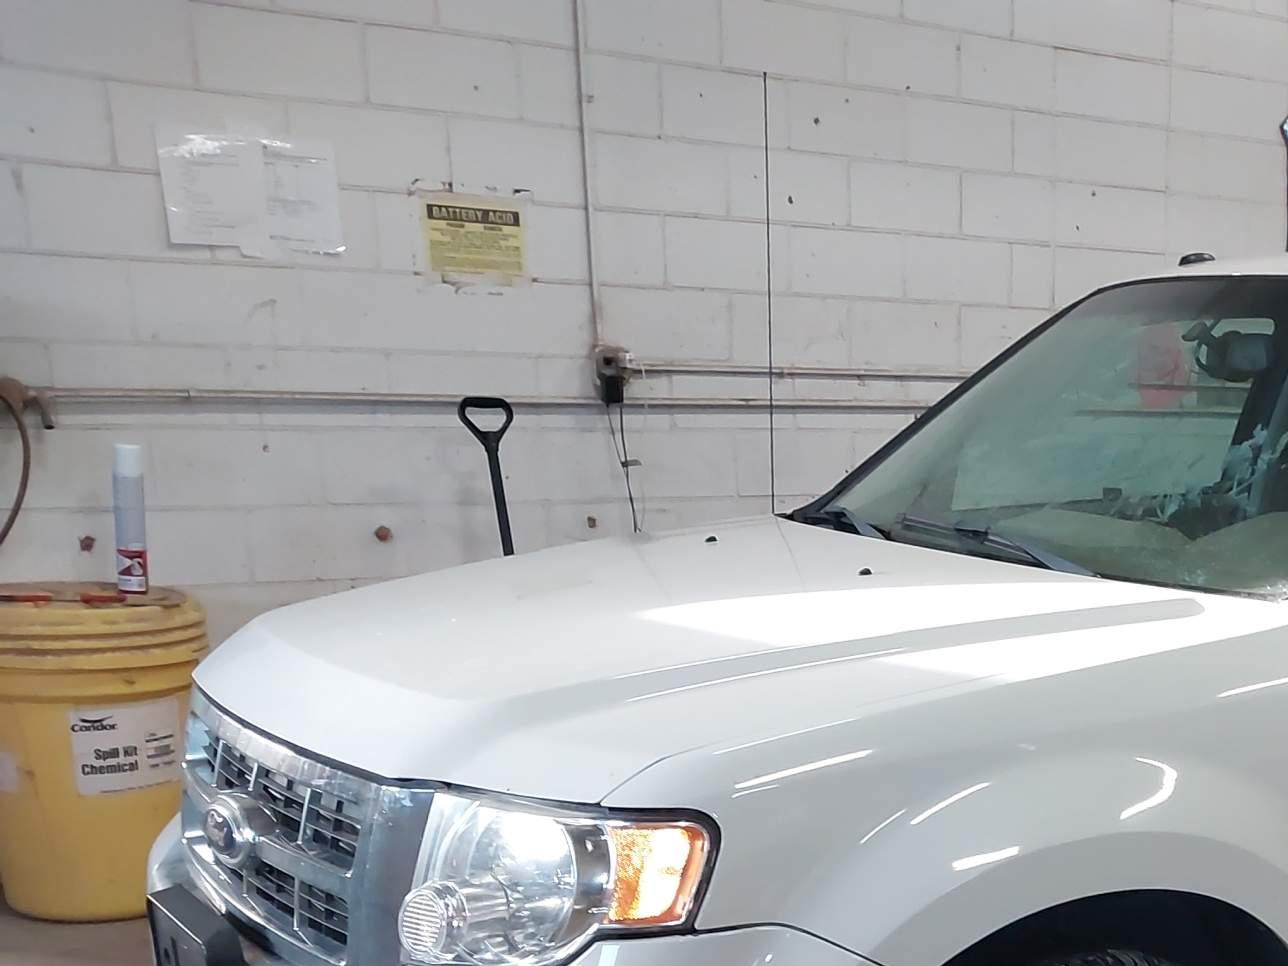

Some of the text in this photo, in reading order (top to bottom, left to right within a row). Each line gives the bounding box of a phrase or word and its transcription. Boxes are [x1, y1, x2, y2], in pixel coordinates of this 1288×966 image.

[432, 206, 514, 224] BATTERY ACID
[70, 723, 118, 733] Condor
[94, 746, 138, 761] Spill Kit
[81, 760, 139, 776] Chemical
